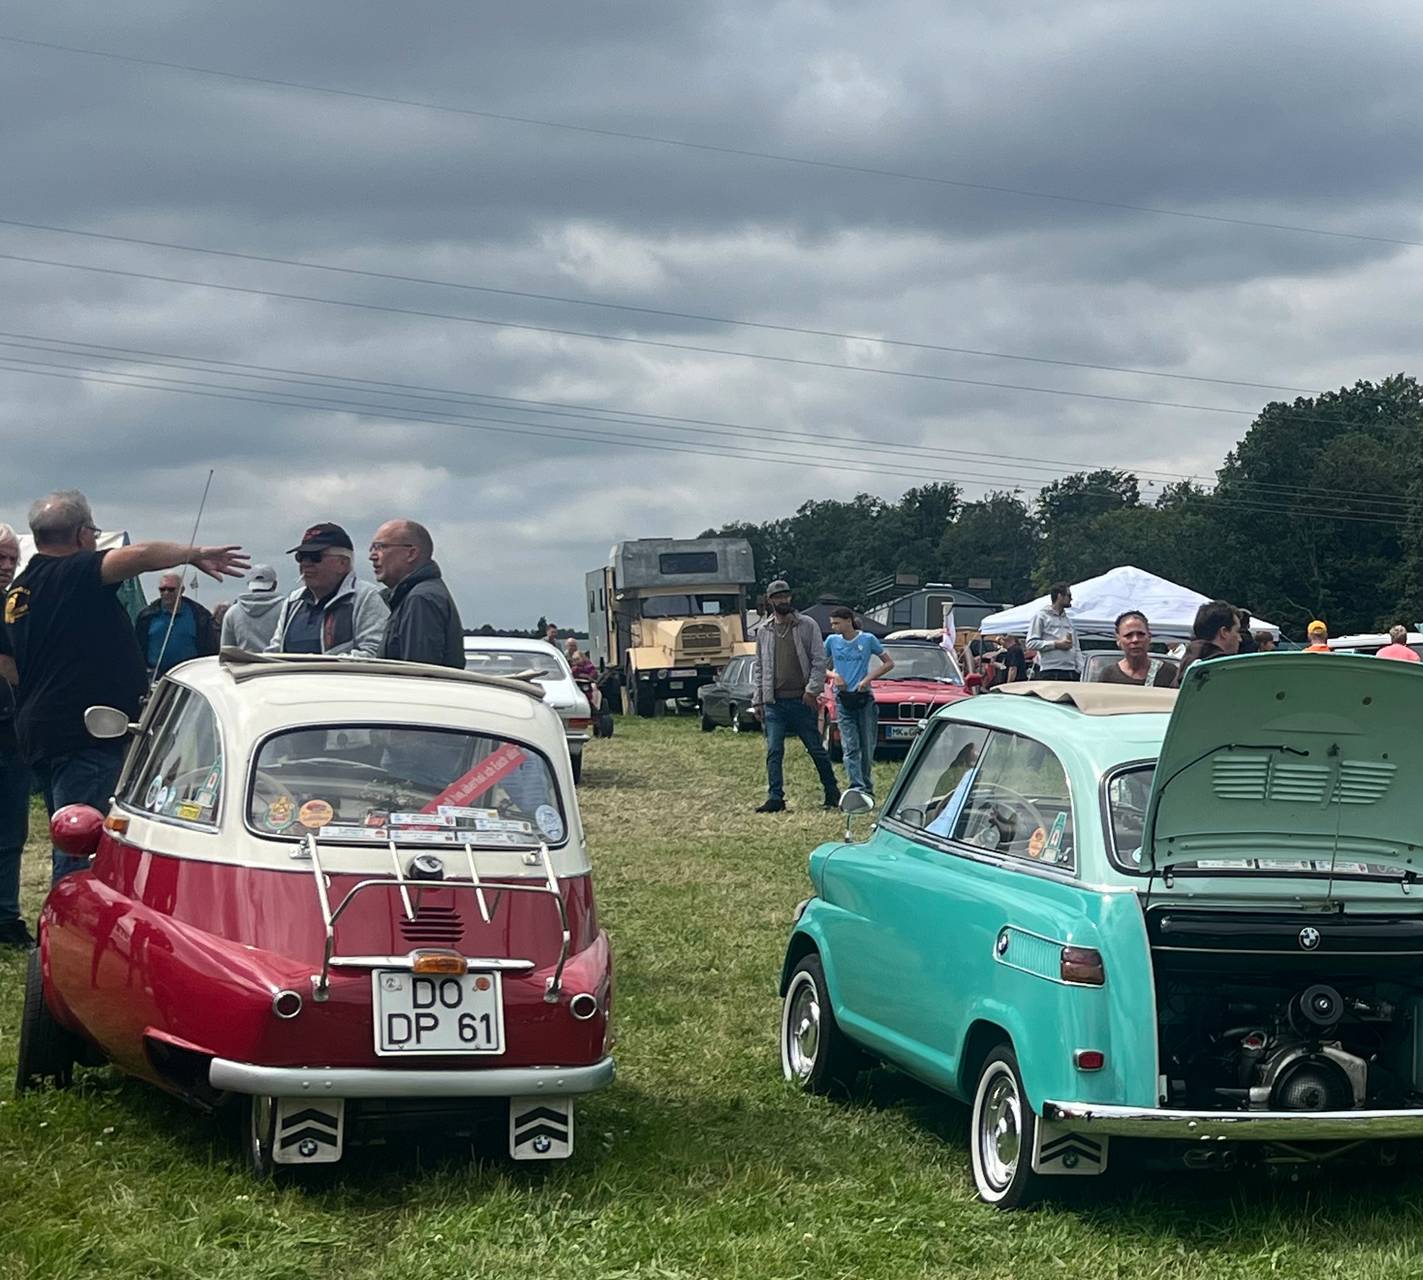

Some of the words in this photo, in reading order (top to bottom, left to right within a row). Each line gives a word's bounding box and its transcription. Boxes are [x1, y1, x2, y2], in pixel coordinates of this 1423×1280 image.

[412, 978, 462, 1008] DO
[388, 1013, 439, 1044] DP
[458, 1013, 491, 1044] 61
